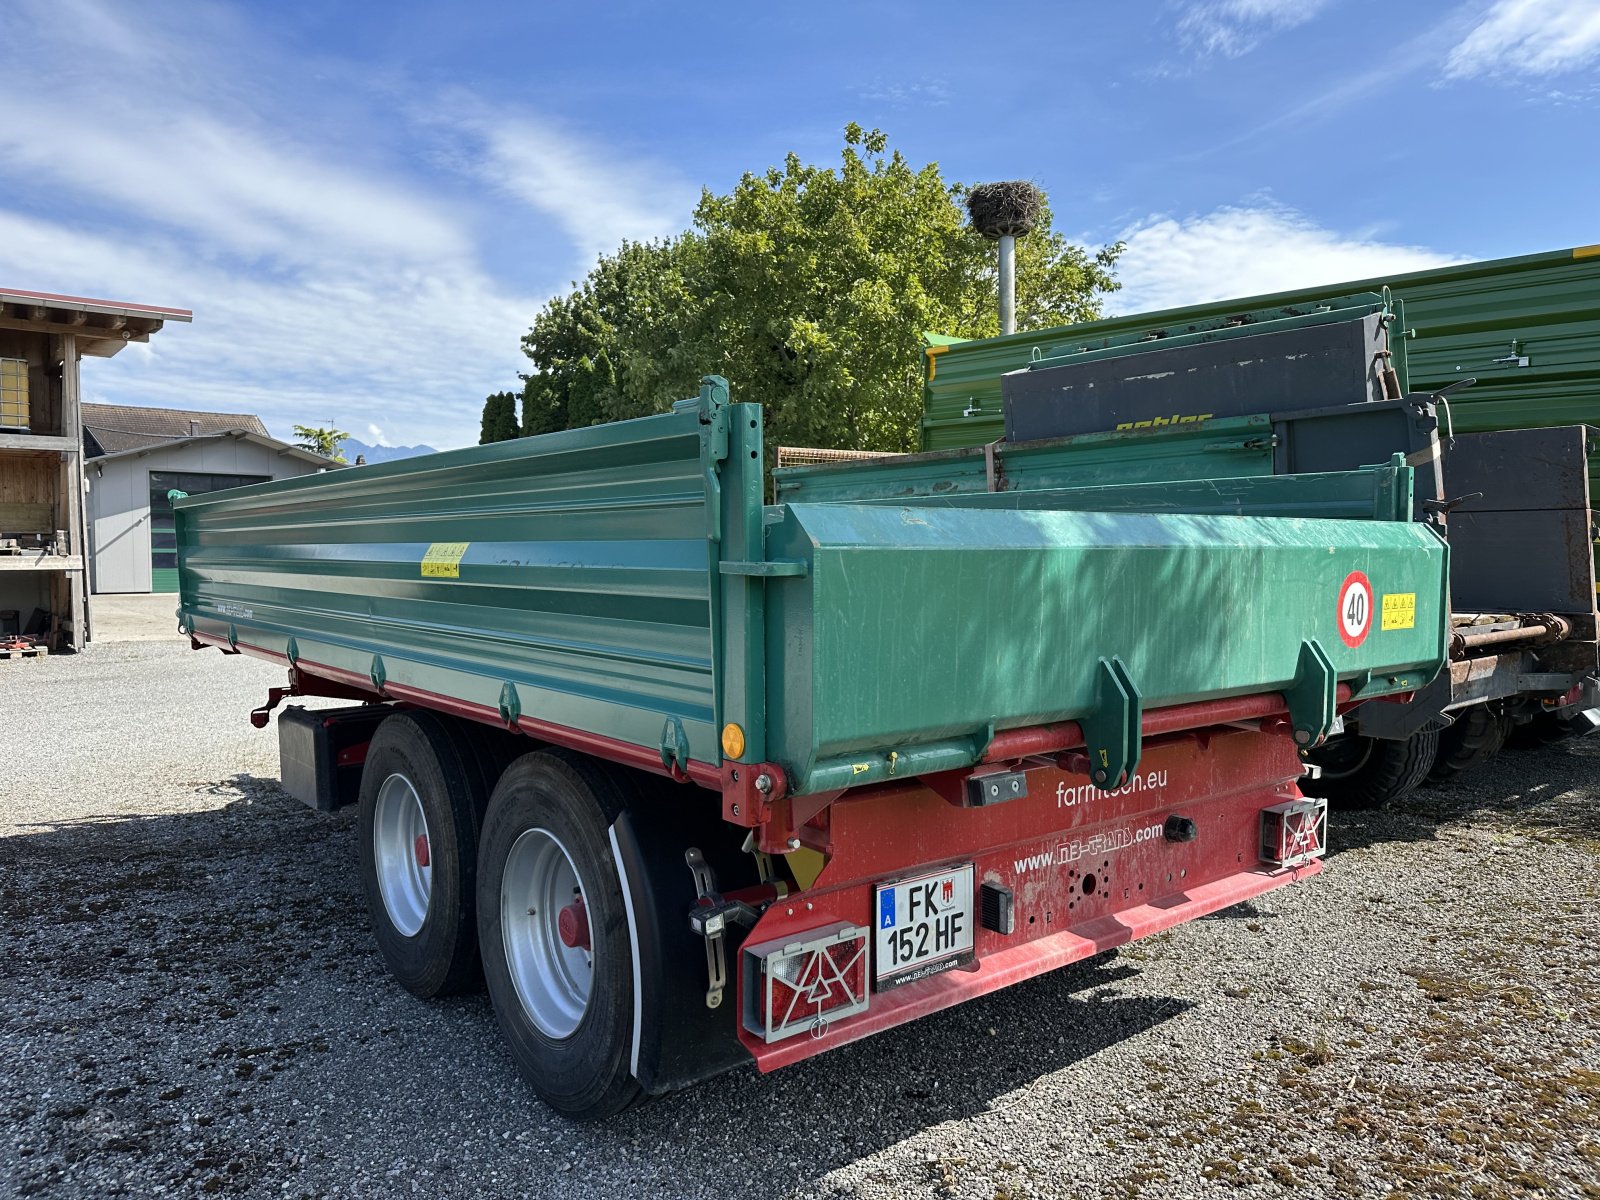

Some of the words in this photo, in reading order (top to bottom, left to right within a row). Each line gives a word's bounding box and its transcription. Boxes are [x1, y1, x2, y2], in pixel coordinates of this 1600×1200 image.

[1347, 592, 1364, 626] 40
[1055, 769, 1168, 808] farmh.eu
[884, 914, 892, 927] A
[909, 881, 939, 922] FK
[888, 922, 929, 966] 152
[935, 911, 964, 952] HF
